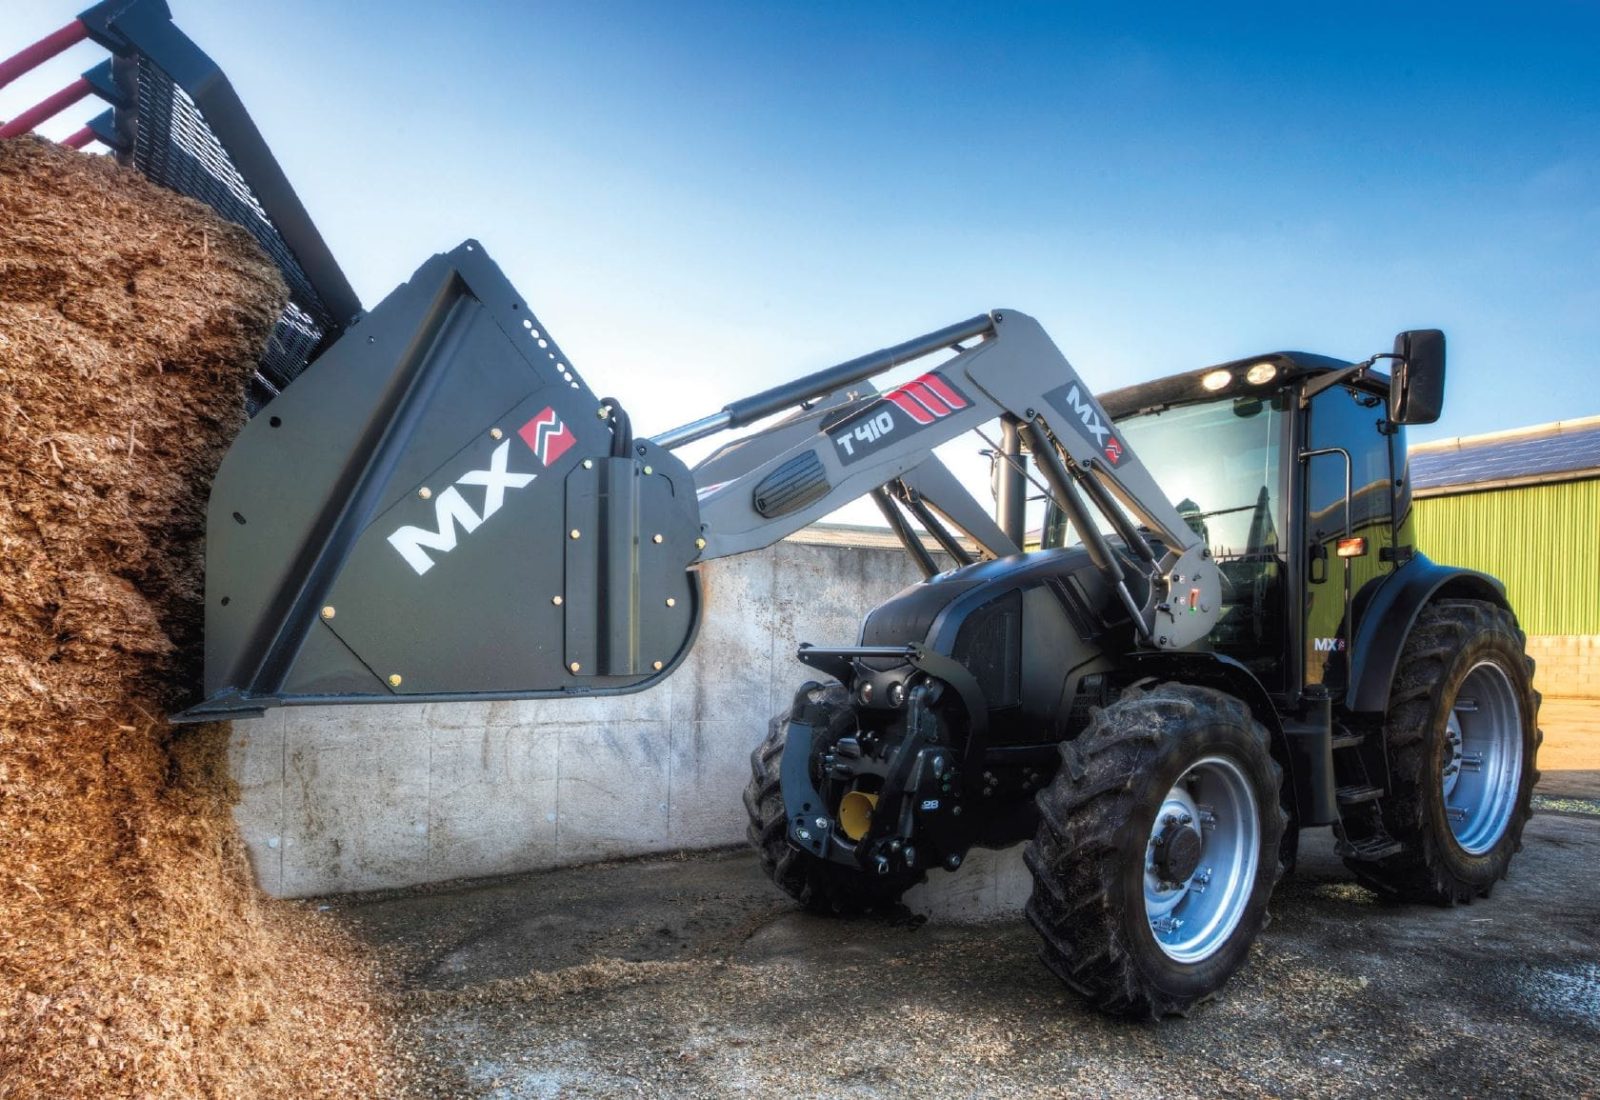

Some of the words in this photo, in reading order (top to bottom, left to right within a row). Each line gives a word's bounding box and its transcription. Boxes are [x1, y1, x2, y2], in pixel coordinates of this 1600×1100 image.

[1066, 385, 1110, 447] MX
[387, 438, 538, 576] MX
[1314, 638, 1337, 651] MX
